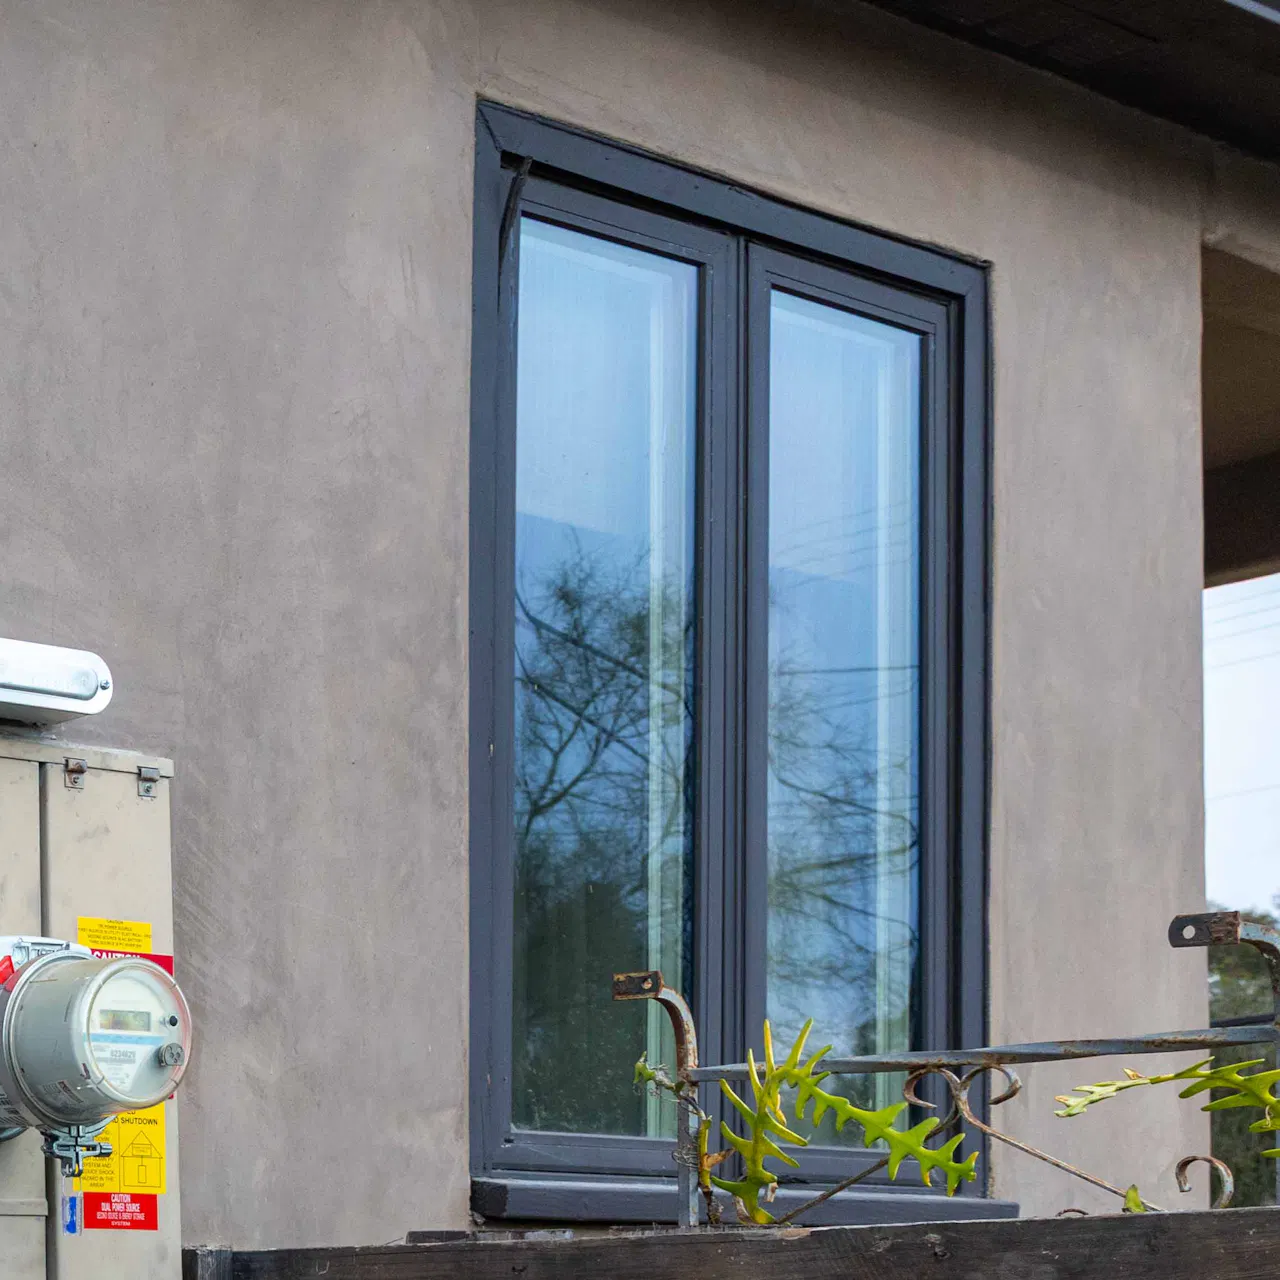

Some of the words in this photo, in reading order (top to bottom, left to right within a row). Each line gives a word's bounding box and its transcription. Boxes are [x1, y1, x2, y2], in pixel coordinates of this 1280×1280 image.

[120, 1116, 158, 1125] SHUTDOWN
[111, 1193, 131, 1202] CAUTION
[101, 1202, 111, 1211] DUAL
[112, 1203, 125, 1212] POWER
[125, 1203, 140, 1212] SOURCE
